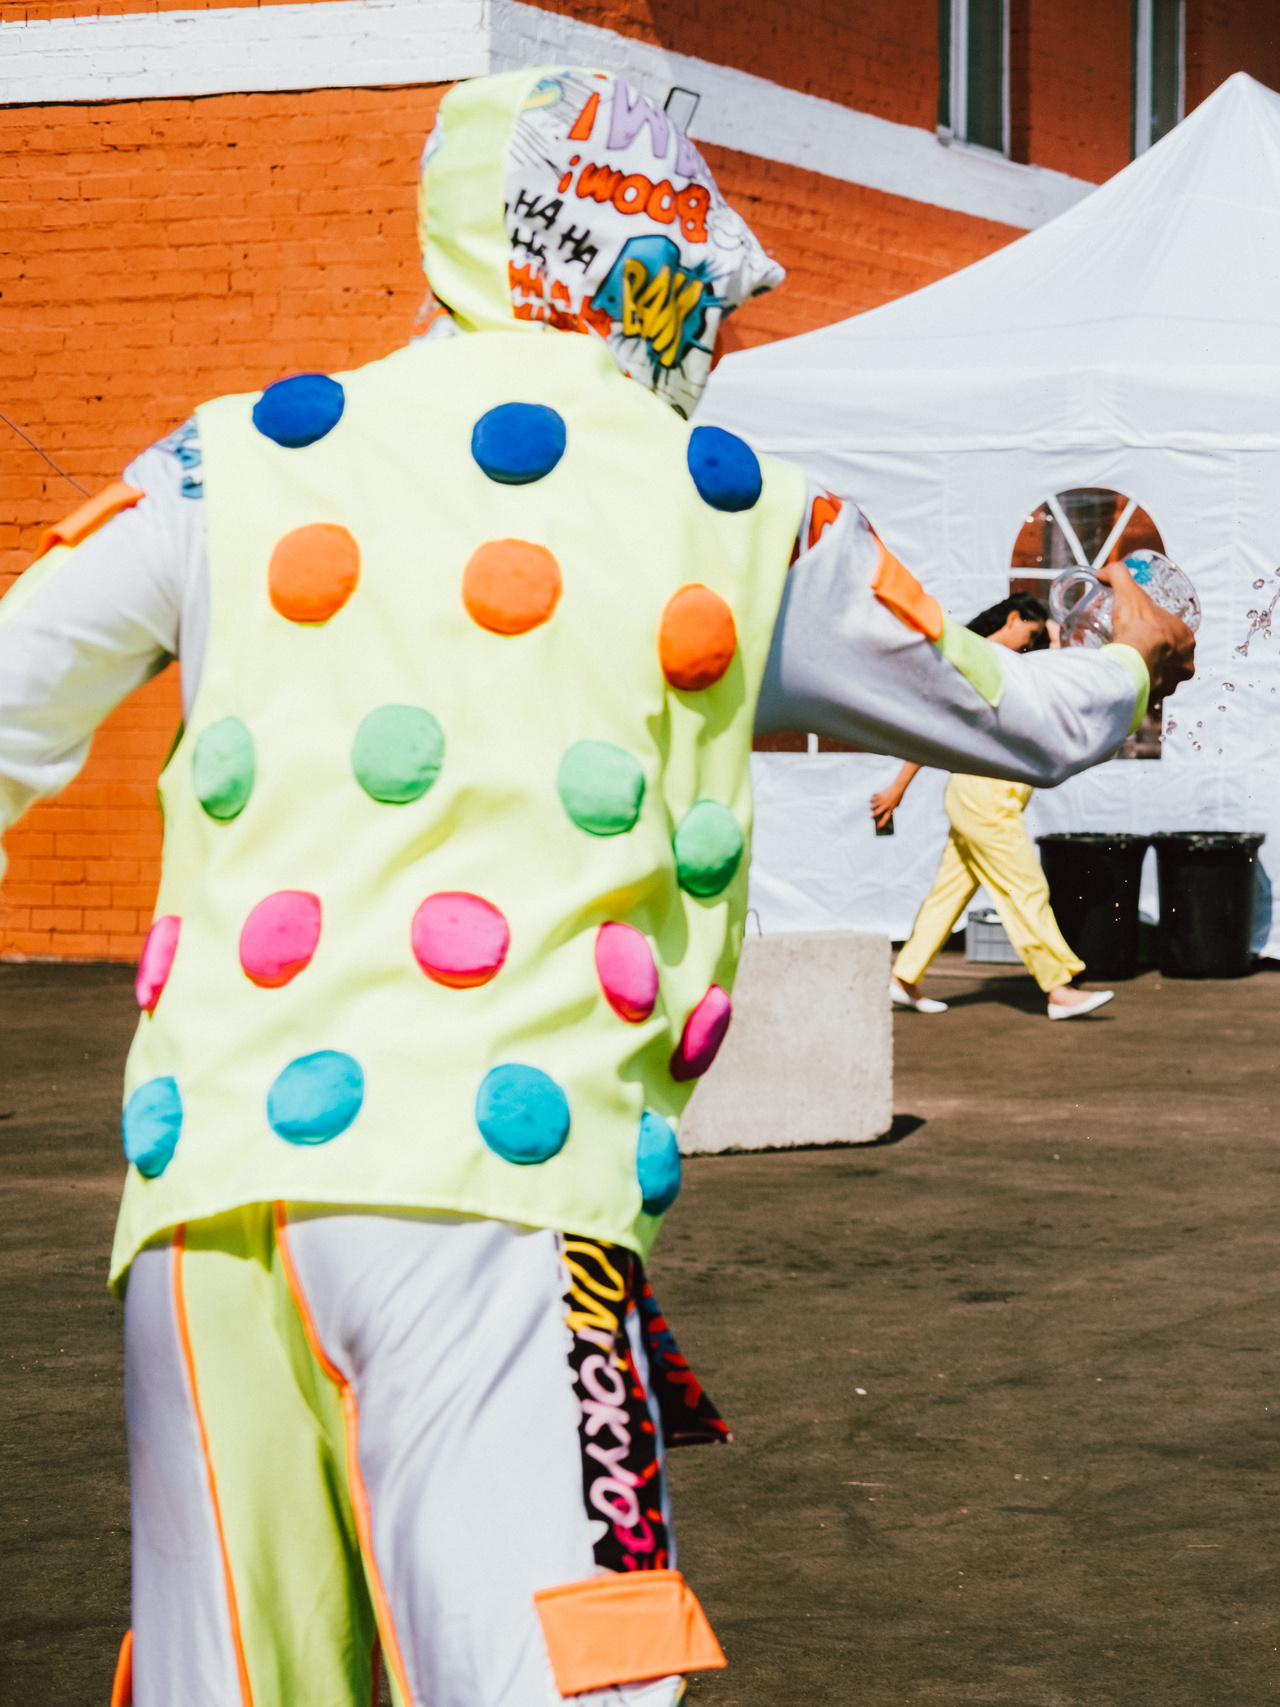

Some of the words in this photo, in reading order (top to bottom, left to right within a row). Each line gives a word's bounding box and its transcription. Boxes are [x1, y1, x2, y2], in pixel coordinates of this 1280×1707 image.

[514, 188, 564, 231] HA
[558, 154, 711, 243] BOOM!
[558, 224, 599, 275] HA
